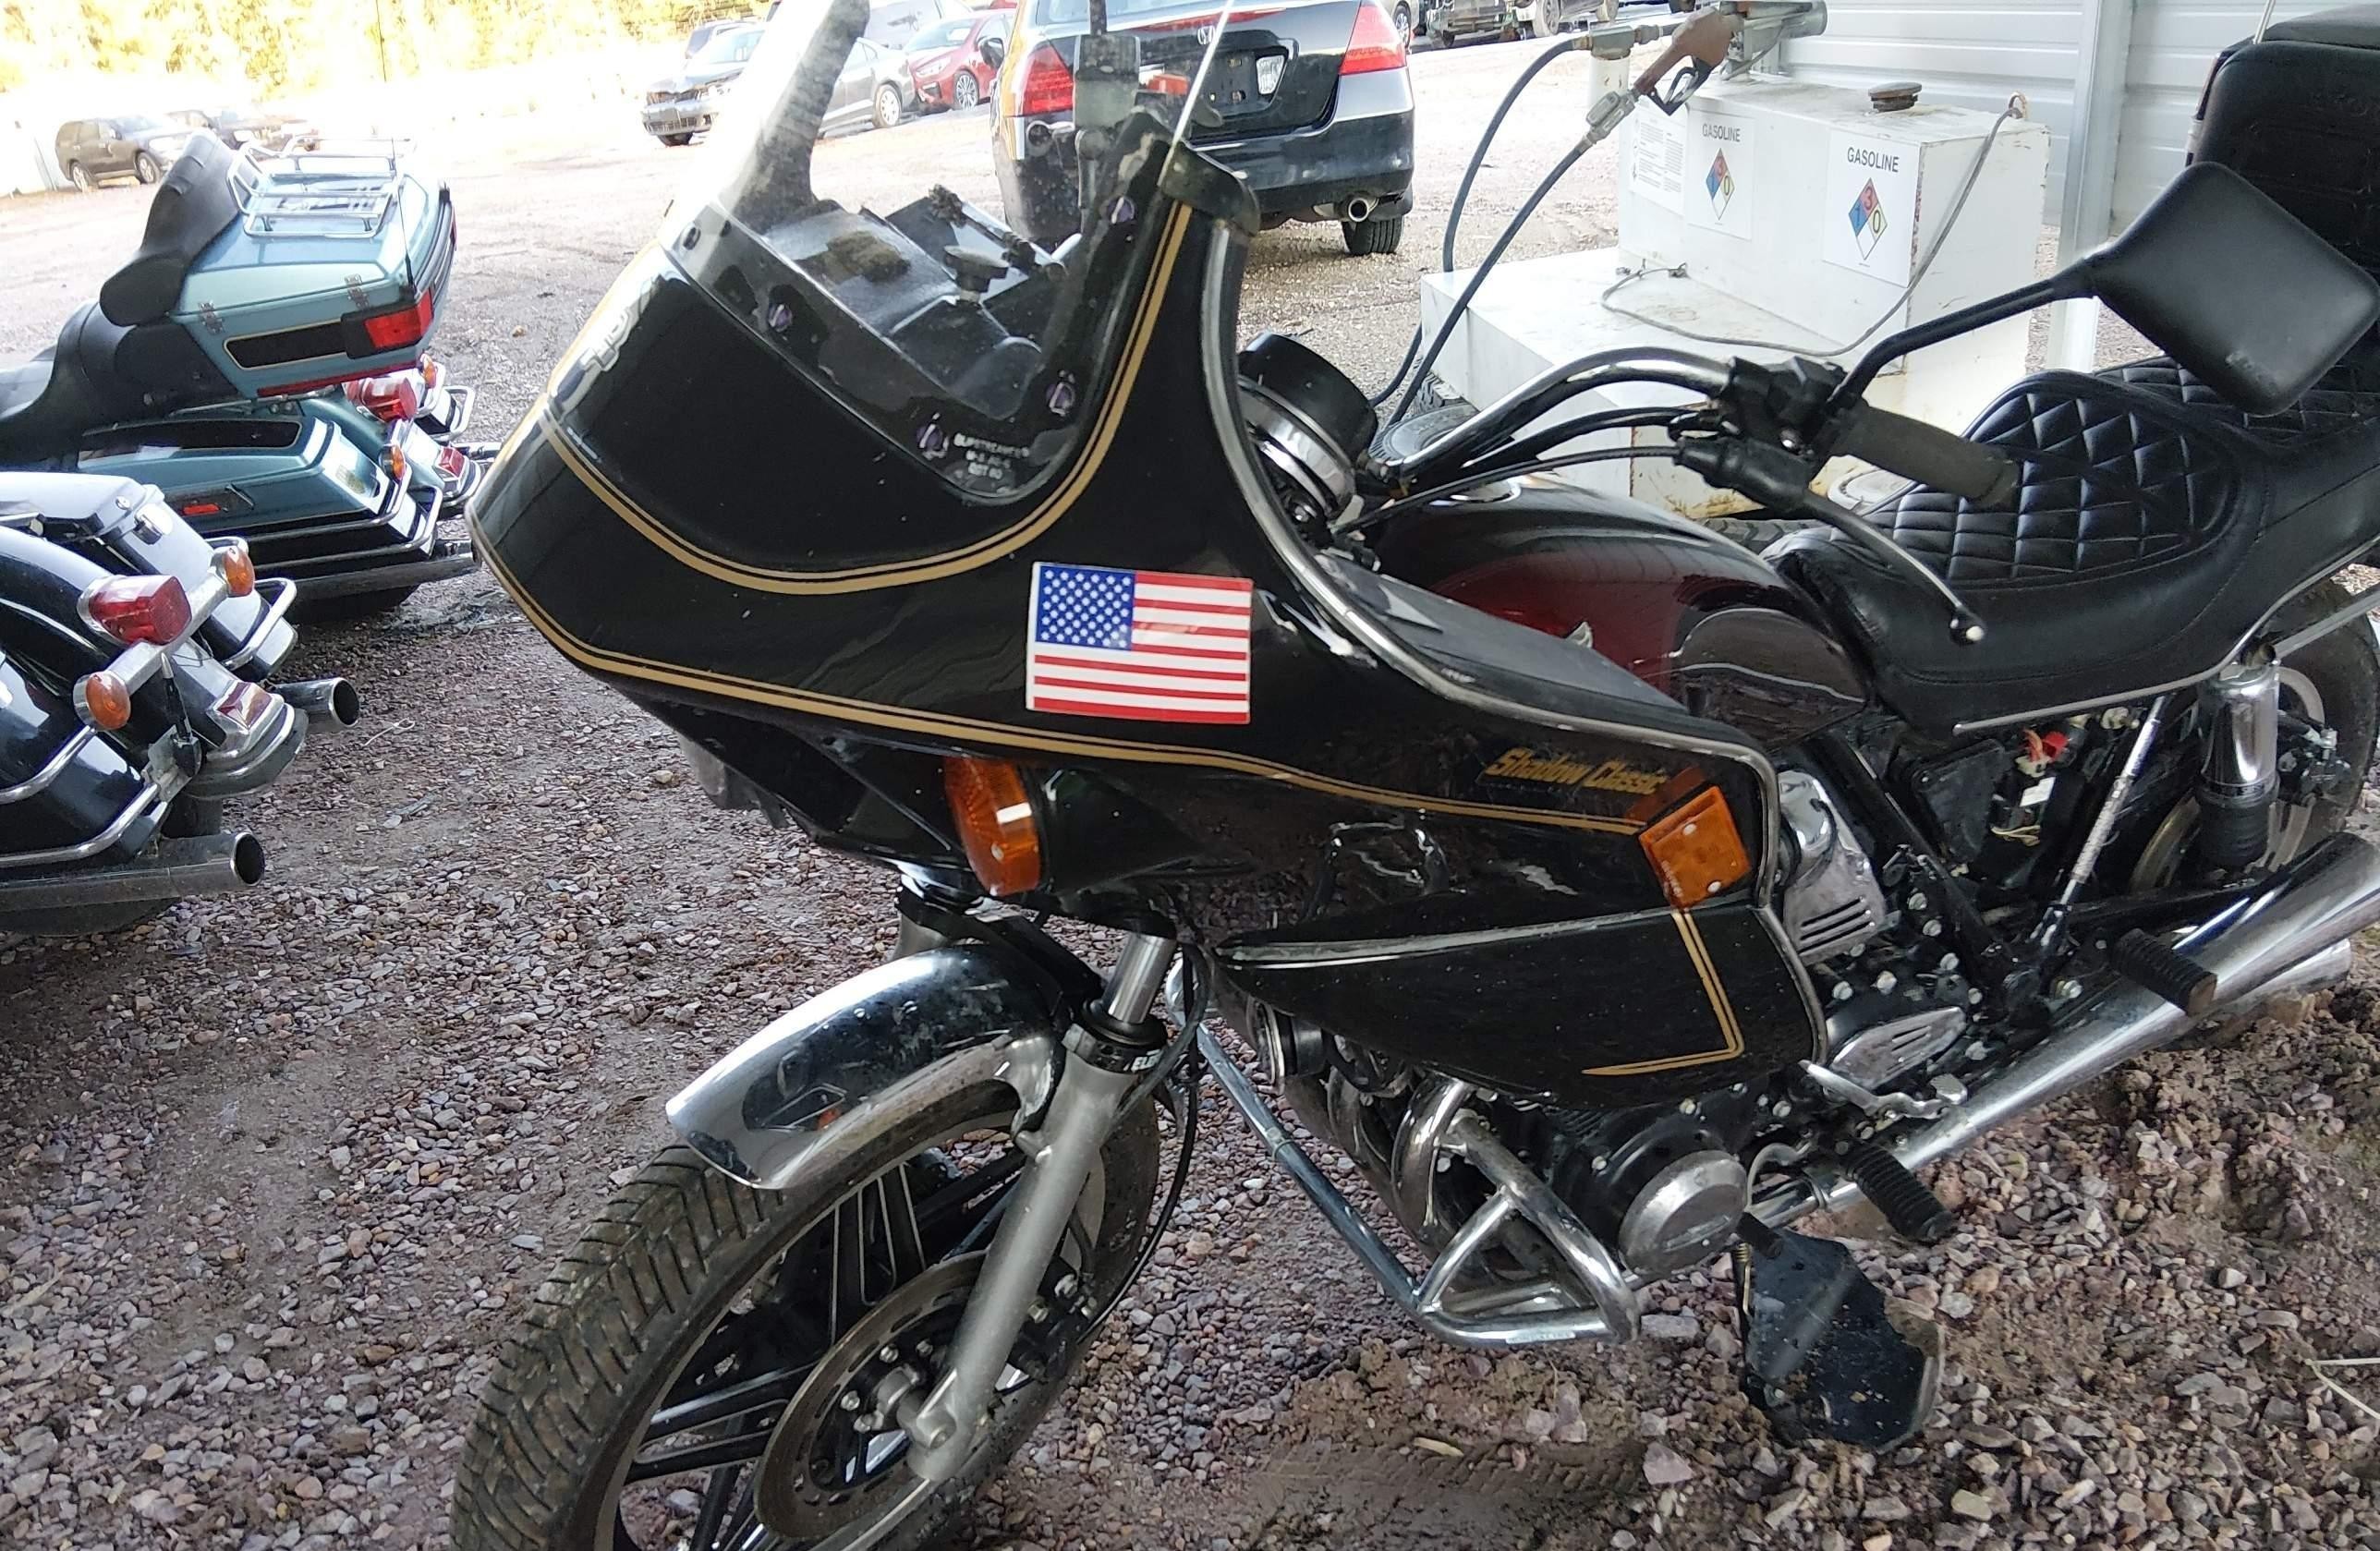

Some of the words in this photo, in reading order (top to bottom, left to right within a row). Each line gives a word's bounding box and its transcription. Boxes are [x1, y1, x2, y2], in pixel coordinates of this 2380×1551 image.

[1702, 123, 1741, 142] GASOLINE
[1847, 146, 1900, 173] GASOLINE
[1724, 175, 1730, 196] 0
[1864, 186, 1874, 211] 3
[1873, 210, 1881, 234] 0
